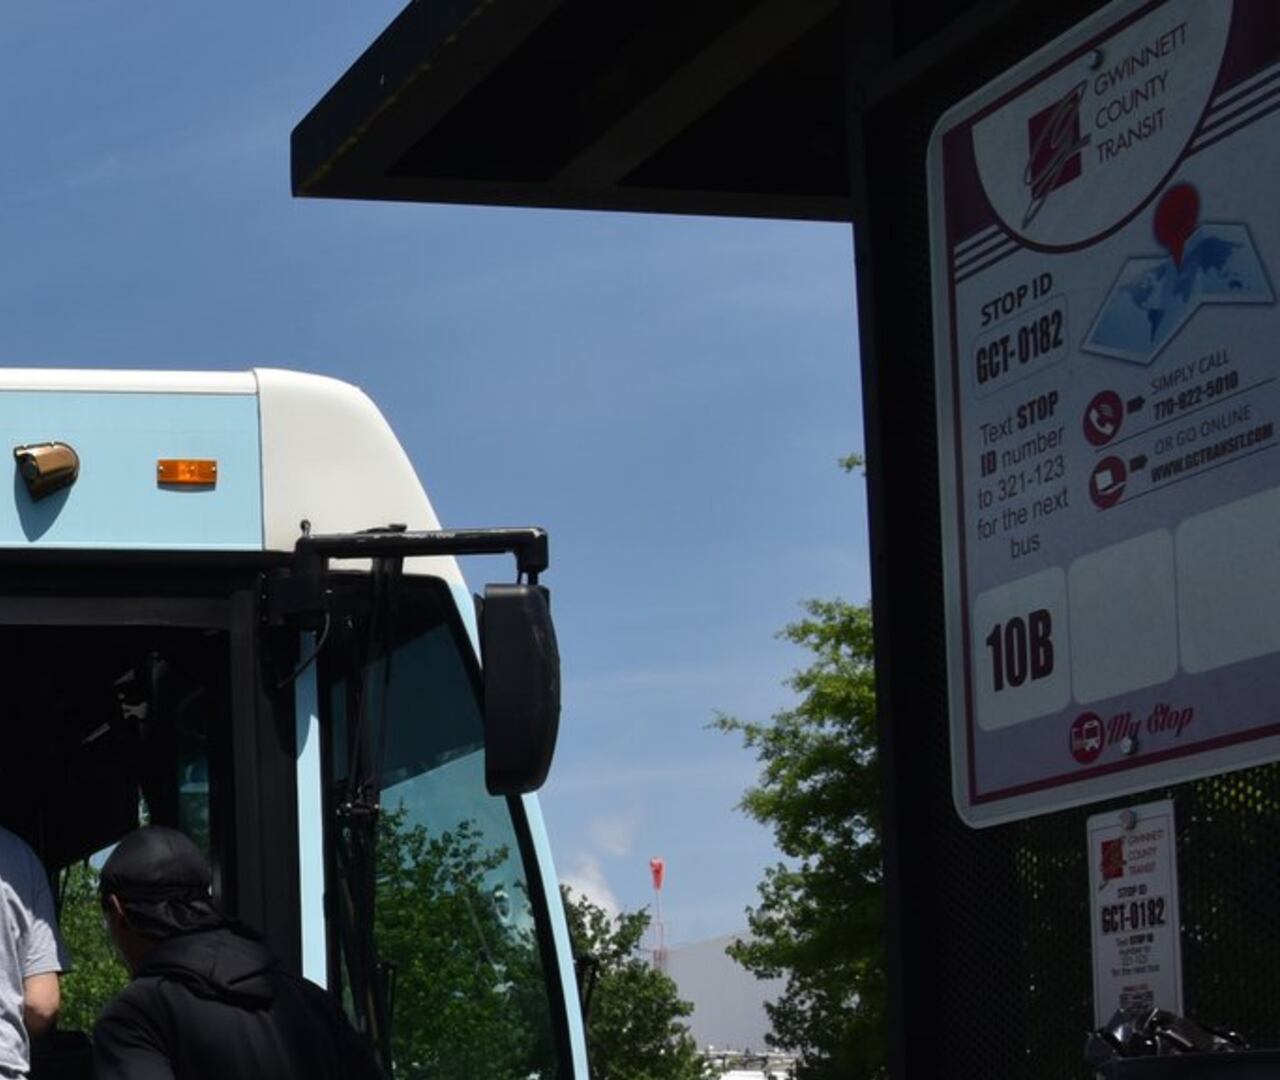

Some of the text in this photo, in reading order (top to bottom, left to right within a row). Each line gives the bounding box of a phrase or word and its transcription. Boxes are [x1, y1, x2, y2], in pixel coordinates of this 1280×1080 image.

[1094, 21, 1188, 96] GWINNETT
[1096, 70, 1168, 129] COUNTY
[1097, 107, 1166, 163] TRANSIT
[981, 272, 1053, 326] STOP ID
[977, 309, 1063, 384] GCT-0182
[1151, 349, 1230, 396] SIMPLY CALL
[979, 389, 1059, 447] Text STOP
[1153, 370, 1239, 420] 770-822-5010
[981, 426, 1066, 477] ID number
[1154, 402, 1252, 455] OR GO ONLINE
[978, 453, 1066, 511] to 321-123
[977, 484, 1070, 541] for the next
[1010, 533, 1040, 559] bus
[986, 609, 1054, 692] 10B
[1108, 703, 1193, 750] My Stop
[1102, 897, 1166, 933] GCT-0182
